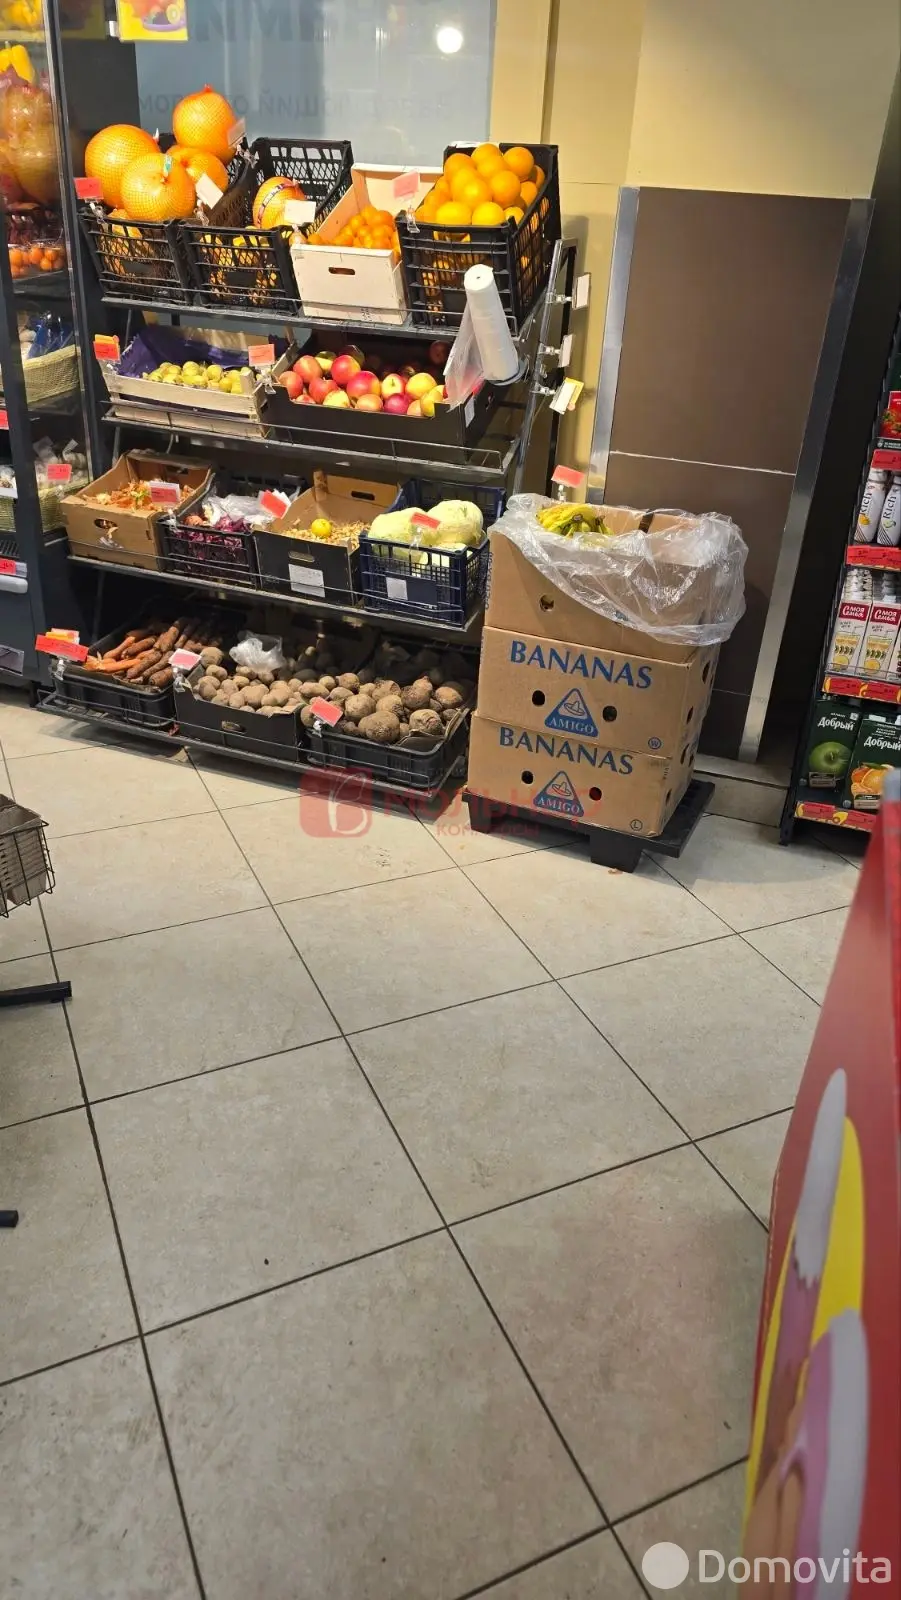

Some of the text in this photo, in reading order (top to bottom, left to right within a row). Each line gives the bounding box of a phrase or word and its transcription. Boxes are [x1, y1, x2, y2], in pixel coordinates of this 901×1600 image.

[882, 495, 897, 519] Rich
[510, 640, 652, 689] BANANAS
[548, 716, 594, 735] AMIGO
[817, 716, 855, 731] Добрый
[499, 726, 633, 775] BANANAS
[536, 797, 581, 815] AMIGO
